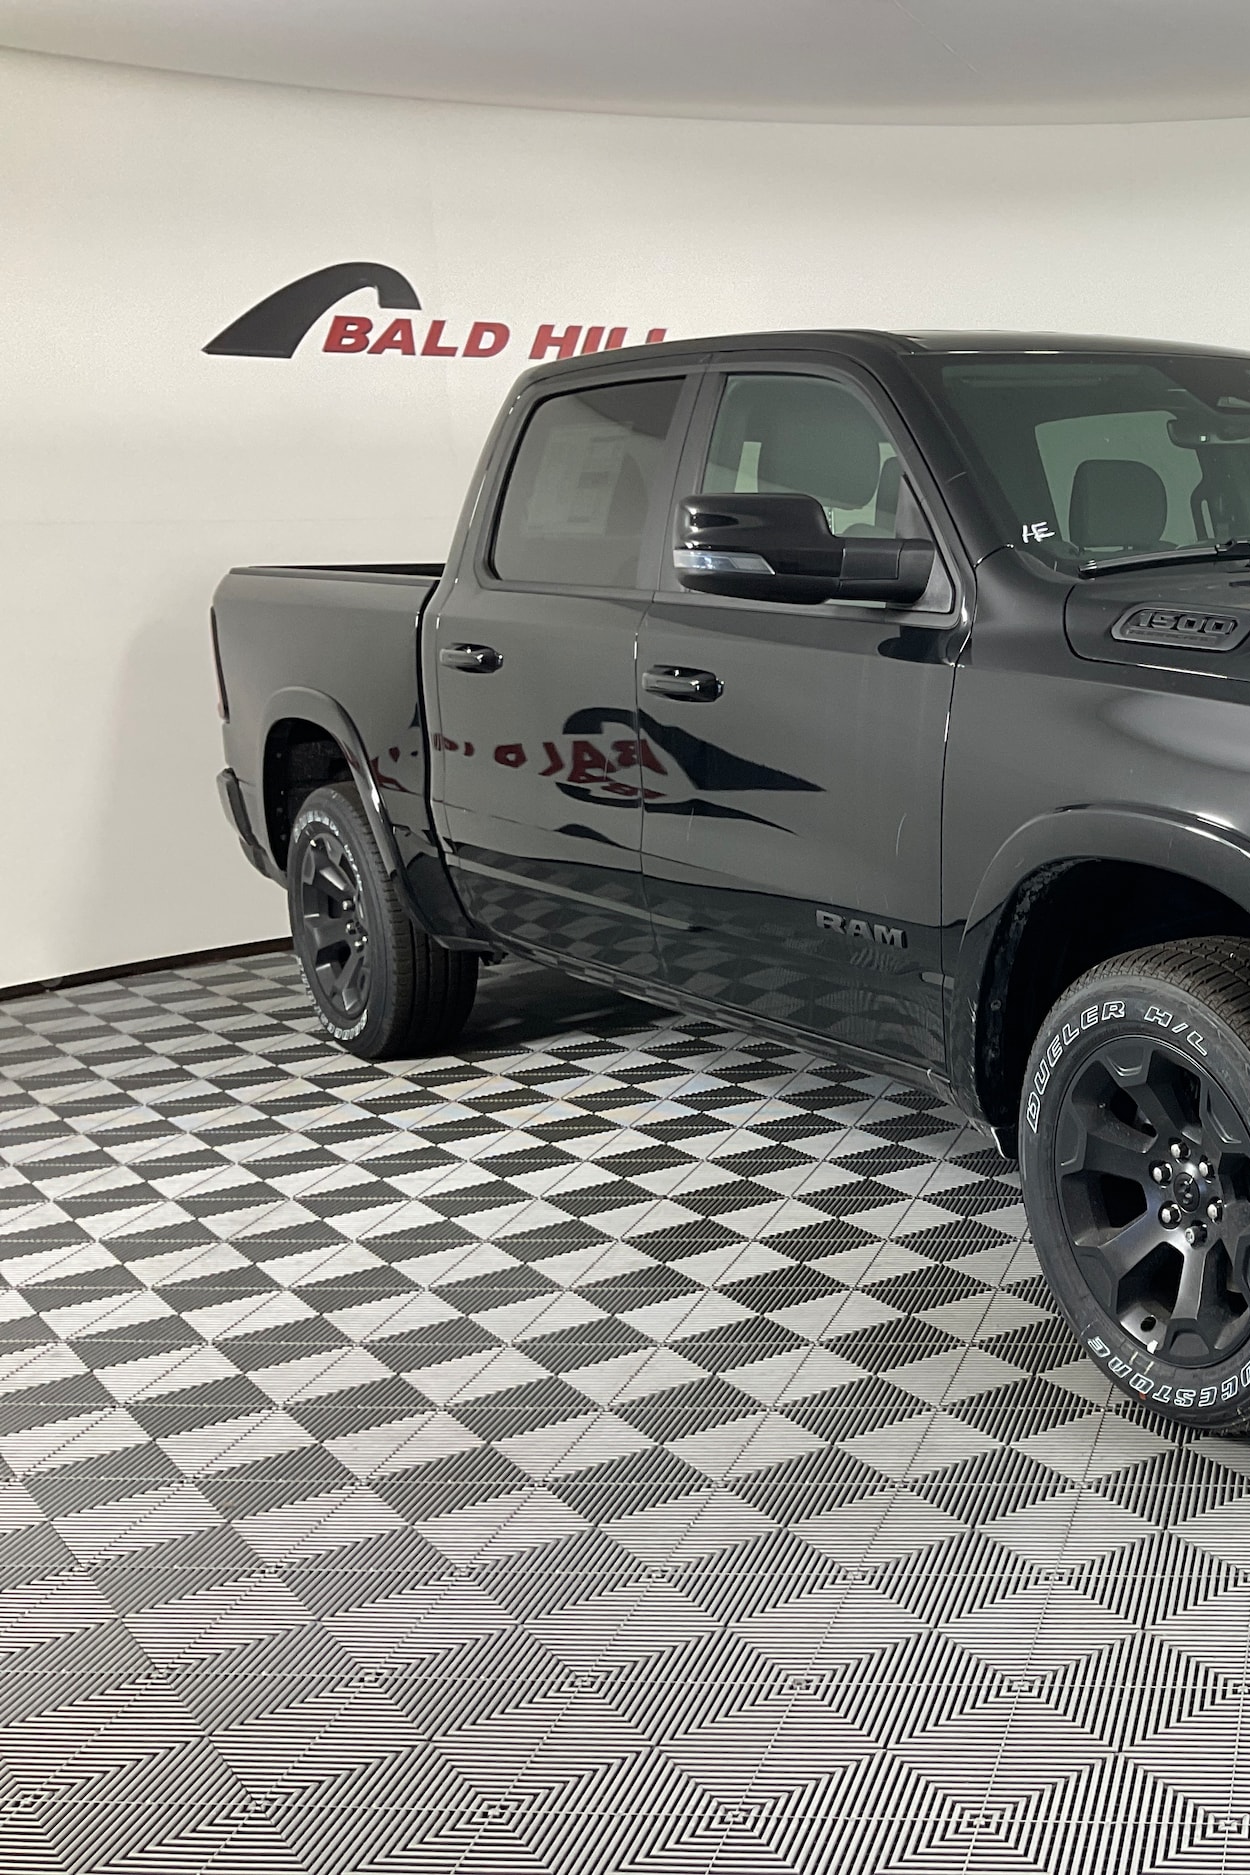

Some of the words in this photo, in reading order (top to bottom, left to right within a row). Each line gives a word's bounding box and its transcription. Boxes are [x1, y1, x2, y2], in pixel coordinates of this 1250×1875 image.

[322, 315, 510, 359] BALD
[1136, 610, 1237, 636] 1500
[815, 909, 907, 949] RAM
[1027, 1000, 1126, 1134] DUELER
[1144, 1006, 1208, 1056] H/L
